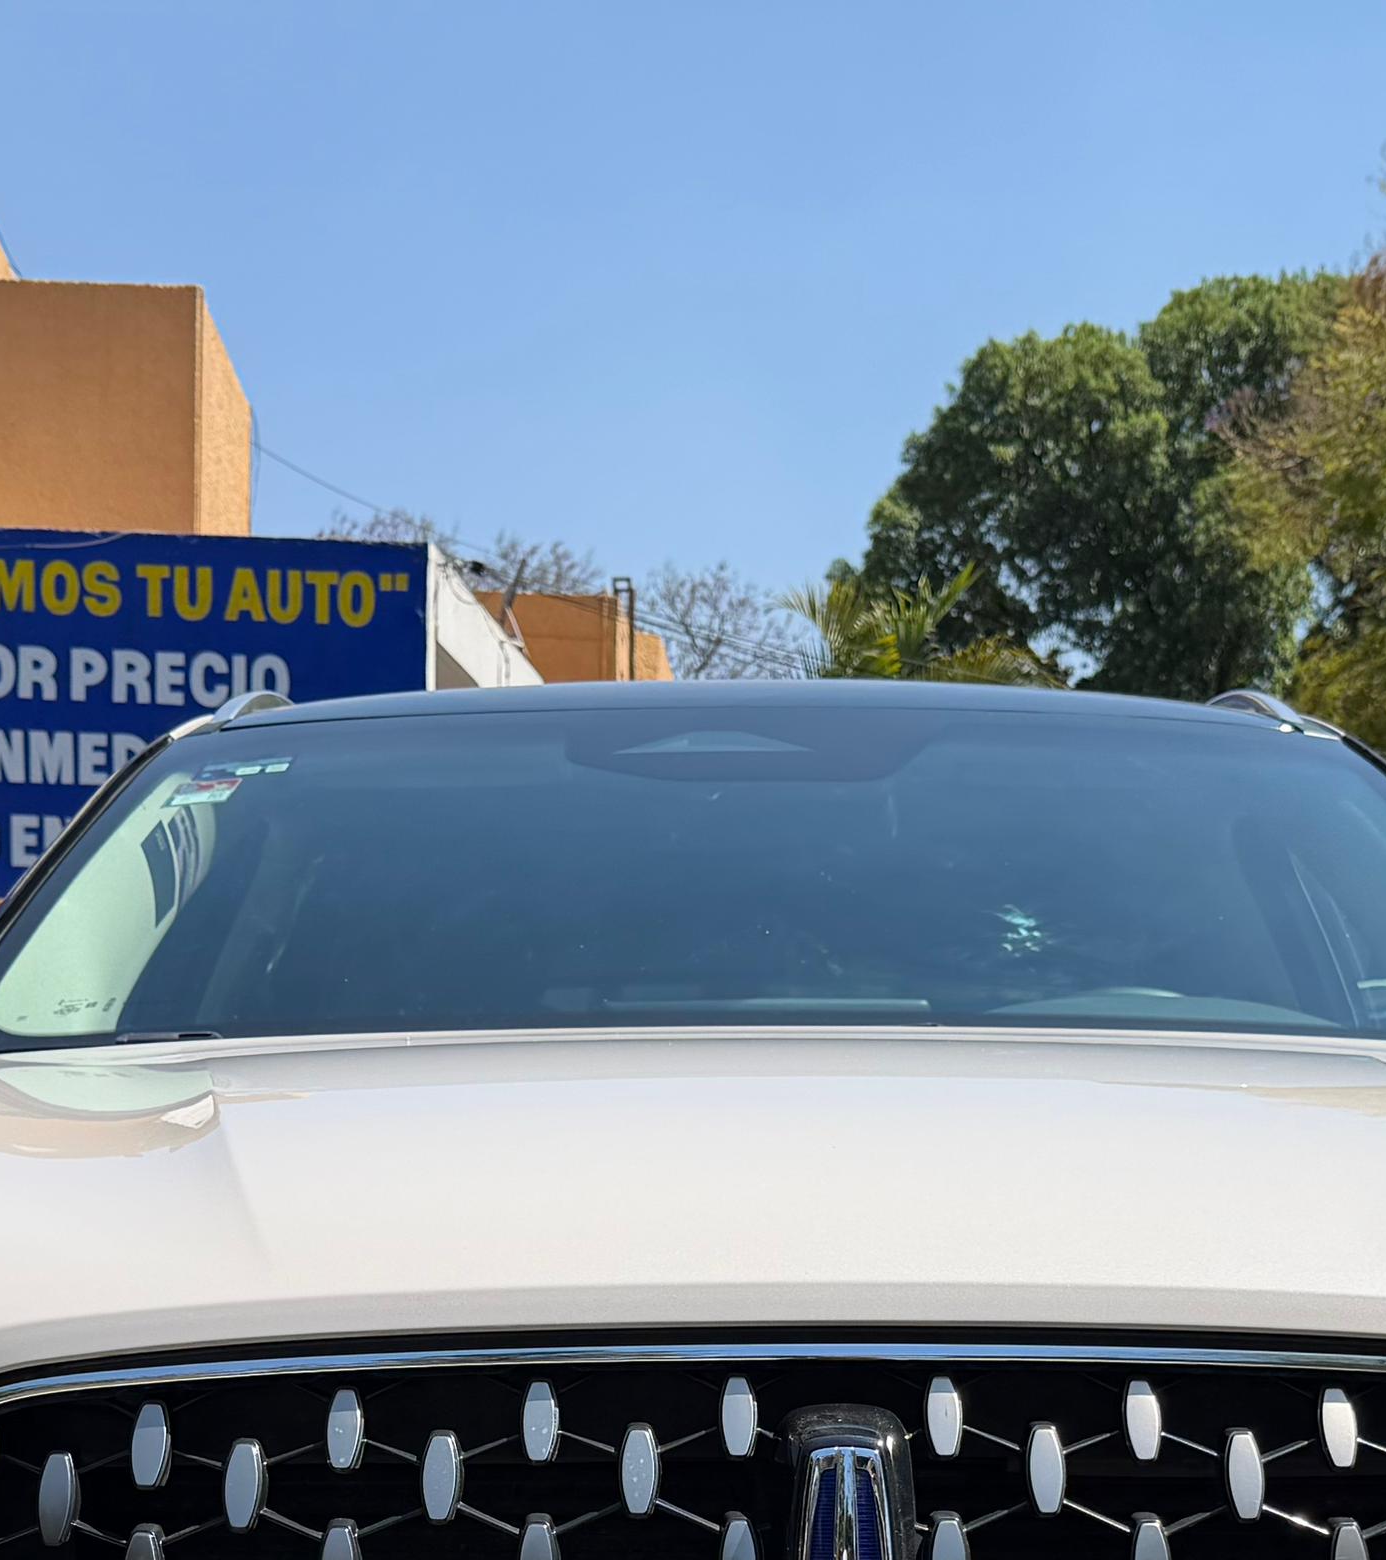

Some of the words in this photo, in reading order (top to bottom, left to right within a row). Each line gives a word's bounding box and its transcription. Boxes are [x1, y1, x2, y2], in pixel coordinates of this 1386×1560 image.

[136, 565, 213, 621] TU
[224, 568, 408, 628] AUTO"
[70, 649, 291, 708] PRECIO
[10, 813, 75, 868] E
